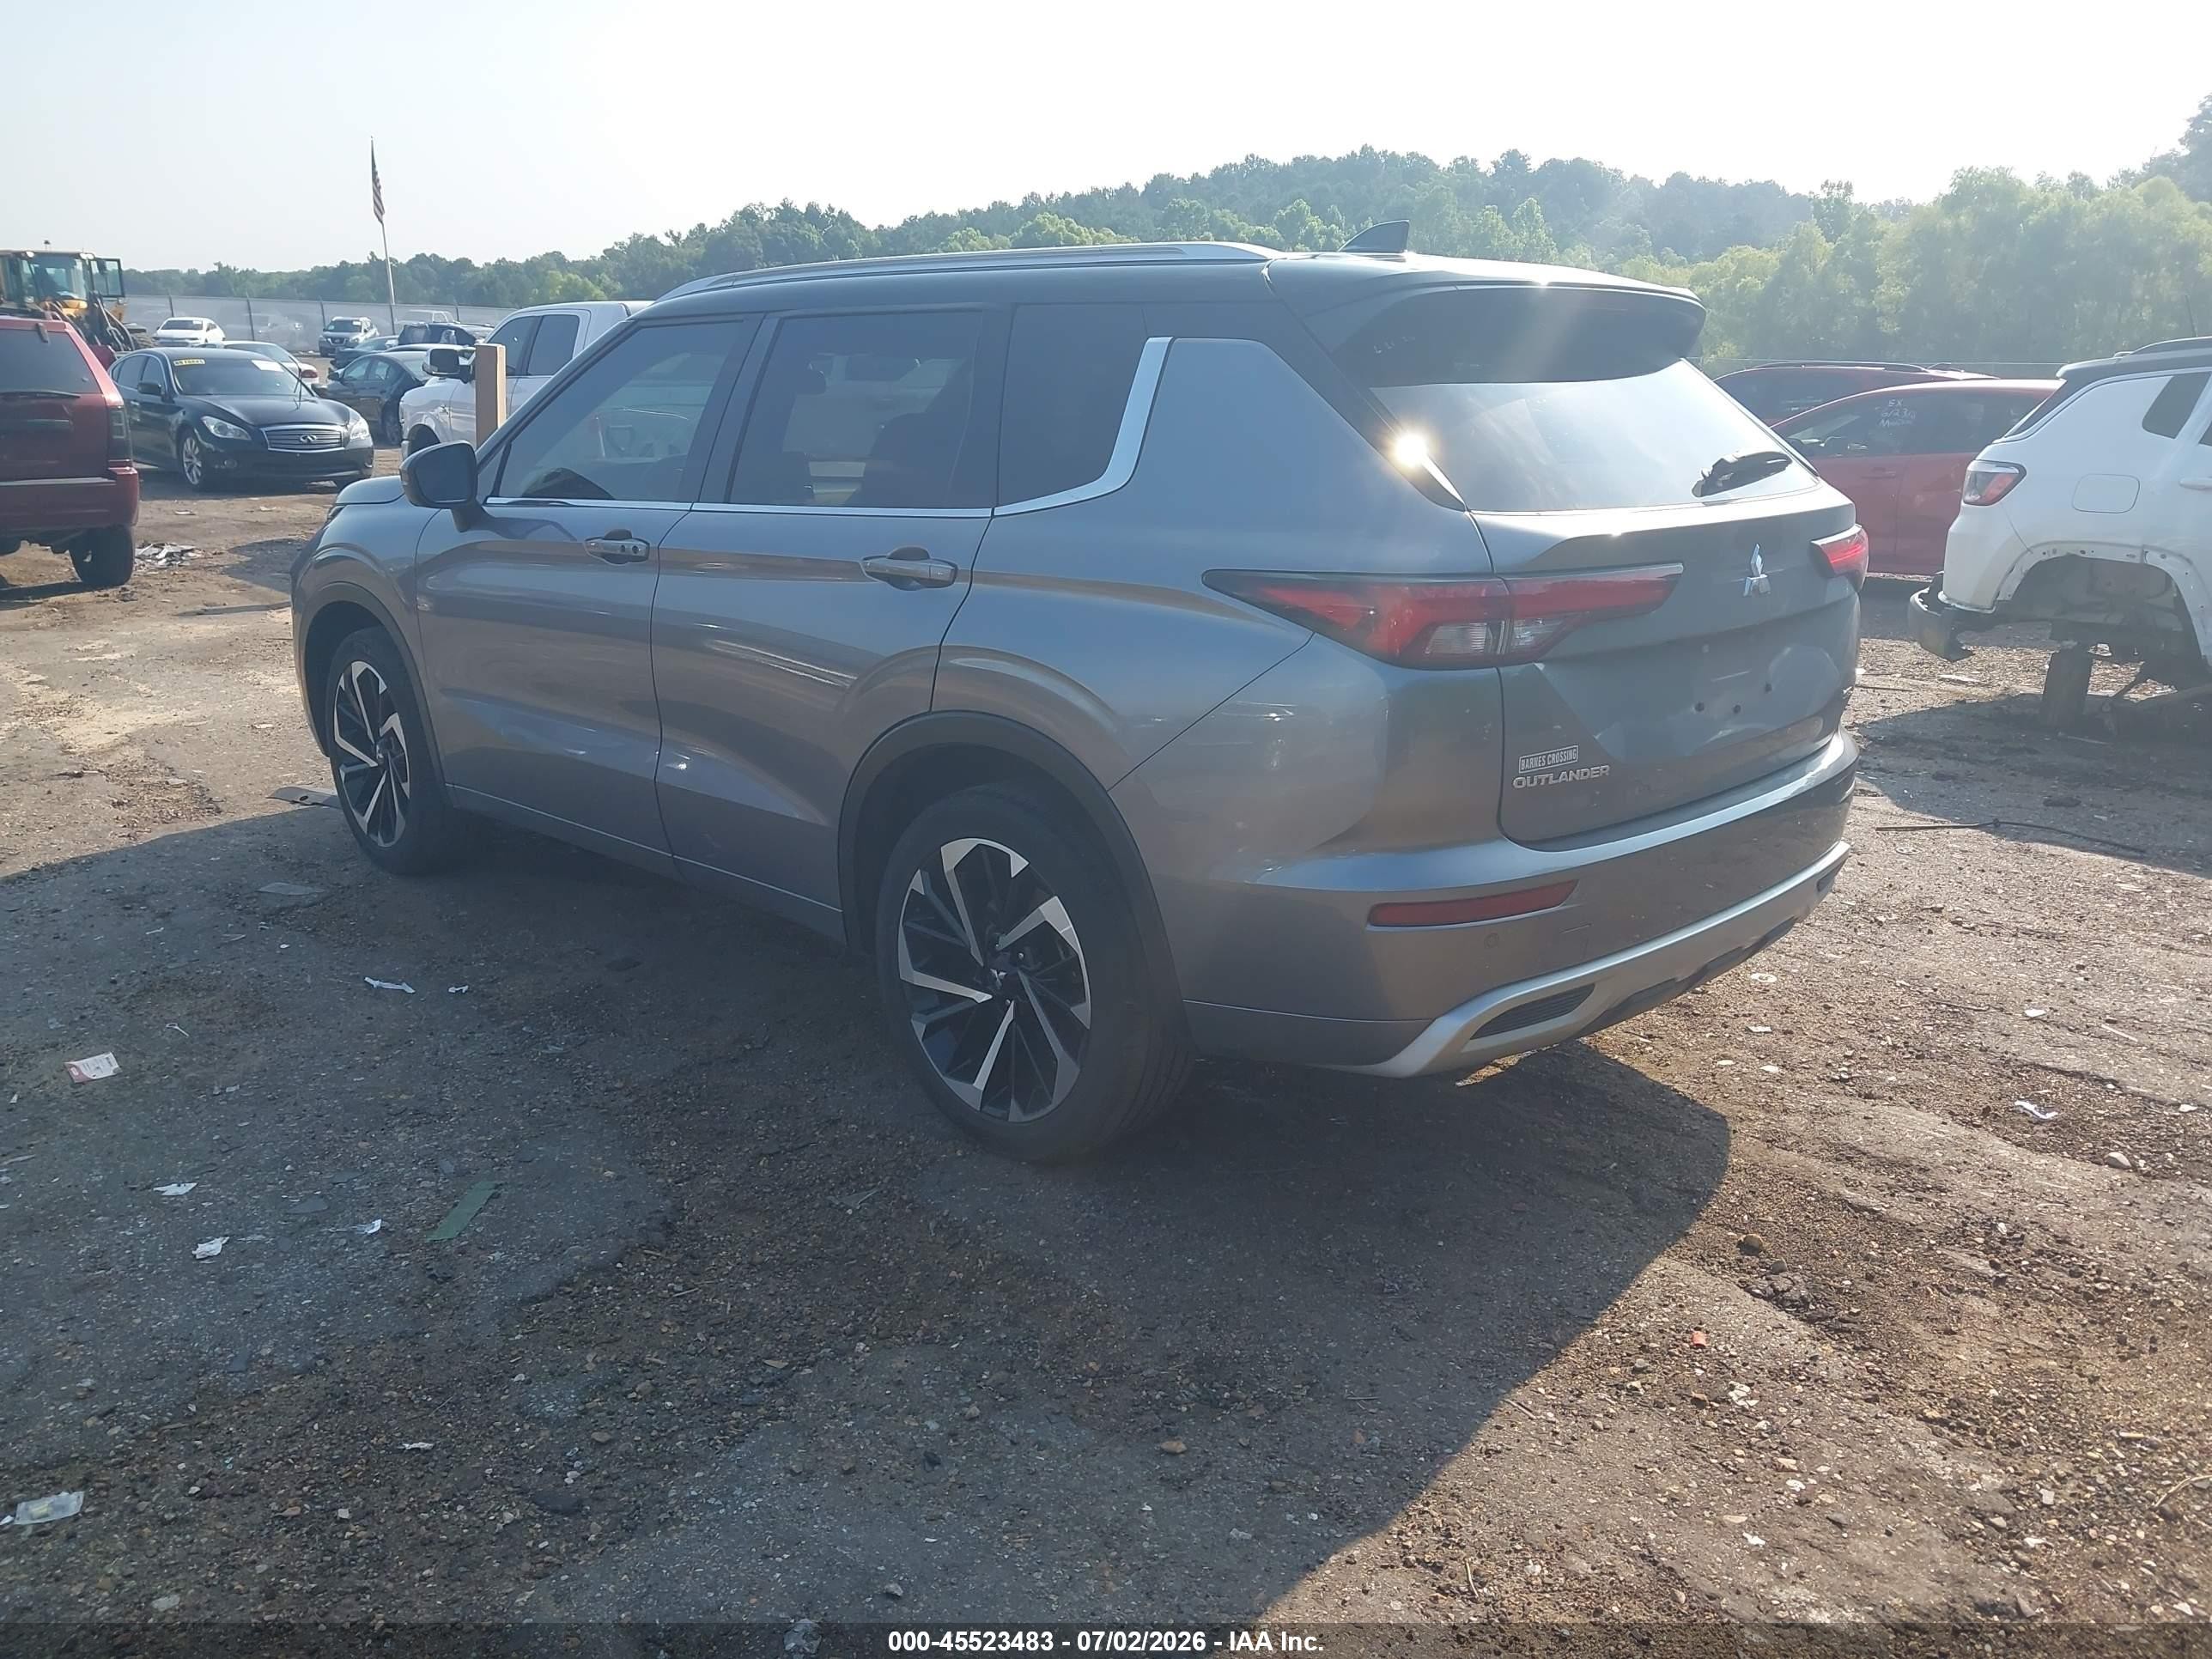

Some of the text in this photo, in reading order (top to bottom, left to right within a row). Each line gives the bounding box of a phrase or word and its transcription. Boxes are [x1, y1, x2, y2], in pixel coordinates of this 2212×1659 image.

[1521, 749, 1577, 770] BARNES CROSSING
[1512, 764, 1611, 789] OUTLANDER
